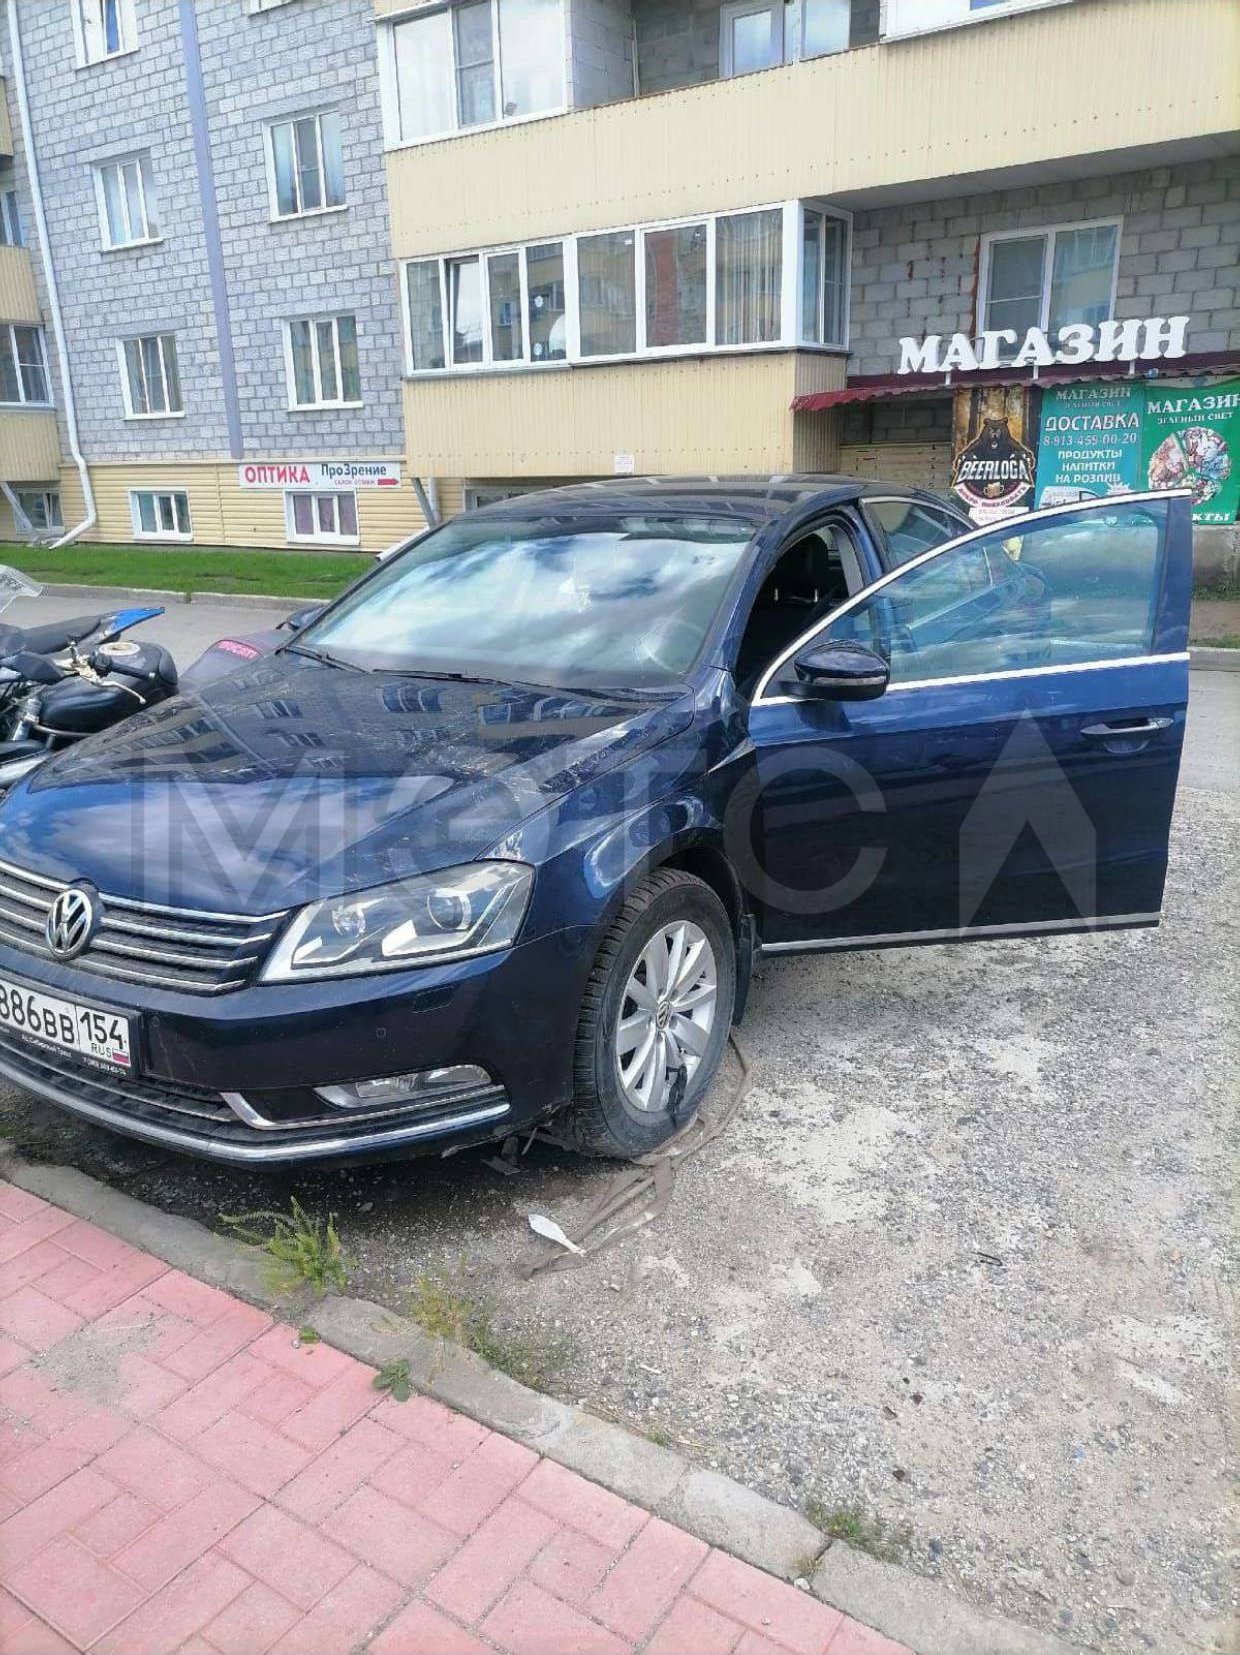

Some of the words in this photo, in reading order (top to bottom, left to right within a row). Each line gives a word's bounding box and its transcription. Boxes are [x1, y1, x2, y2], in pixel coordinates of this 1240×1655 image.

[898, 316, 1190, 374] МАГАЗИН
[1056, 387, 1131, 400] МАГАЗИН
[1045, 412, 1139, 431] ДОСТАВКА
[1058, 449, 1122, 460] ПРОДУКТЫ
[245, 463, 311, 484] ОПТИКА
[321, 463, 387, 479] ПроЗрение
[956, 460, 1030, 483] BEERLOGA
[1062, 461, 1116, 471] НАПИТКИ
[1055, 474, 1071, 483] НА
[1073, 473, 1121, 483] РОЗЛИВ
[79, 1011, 124, 1050] 154
[91, 1043, 112, 1059] RUS
